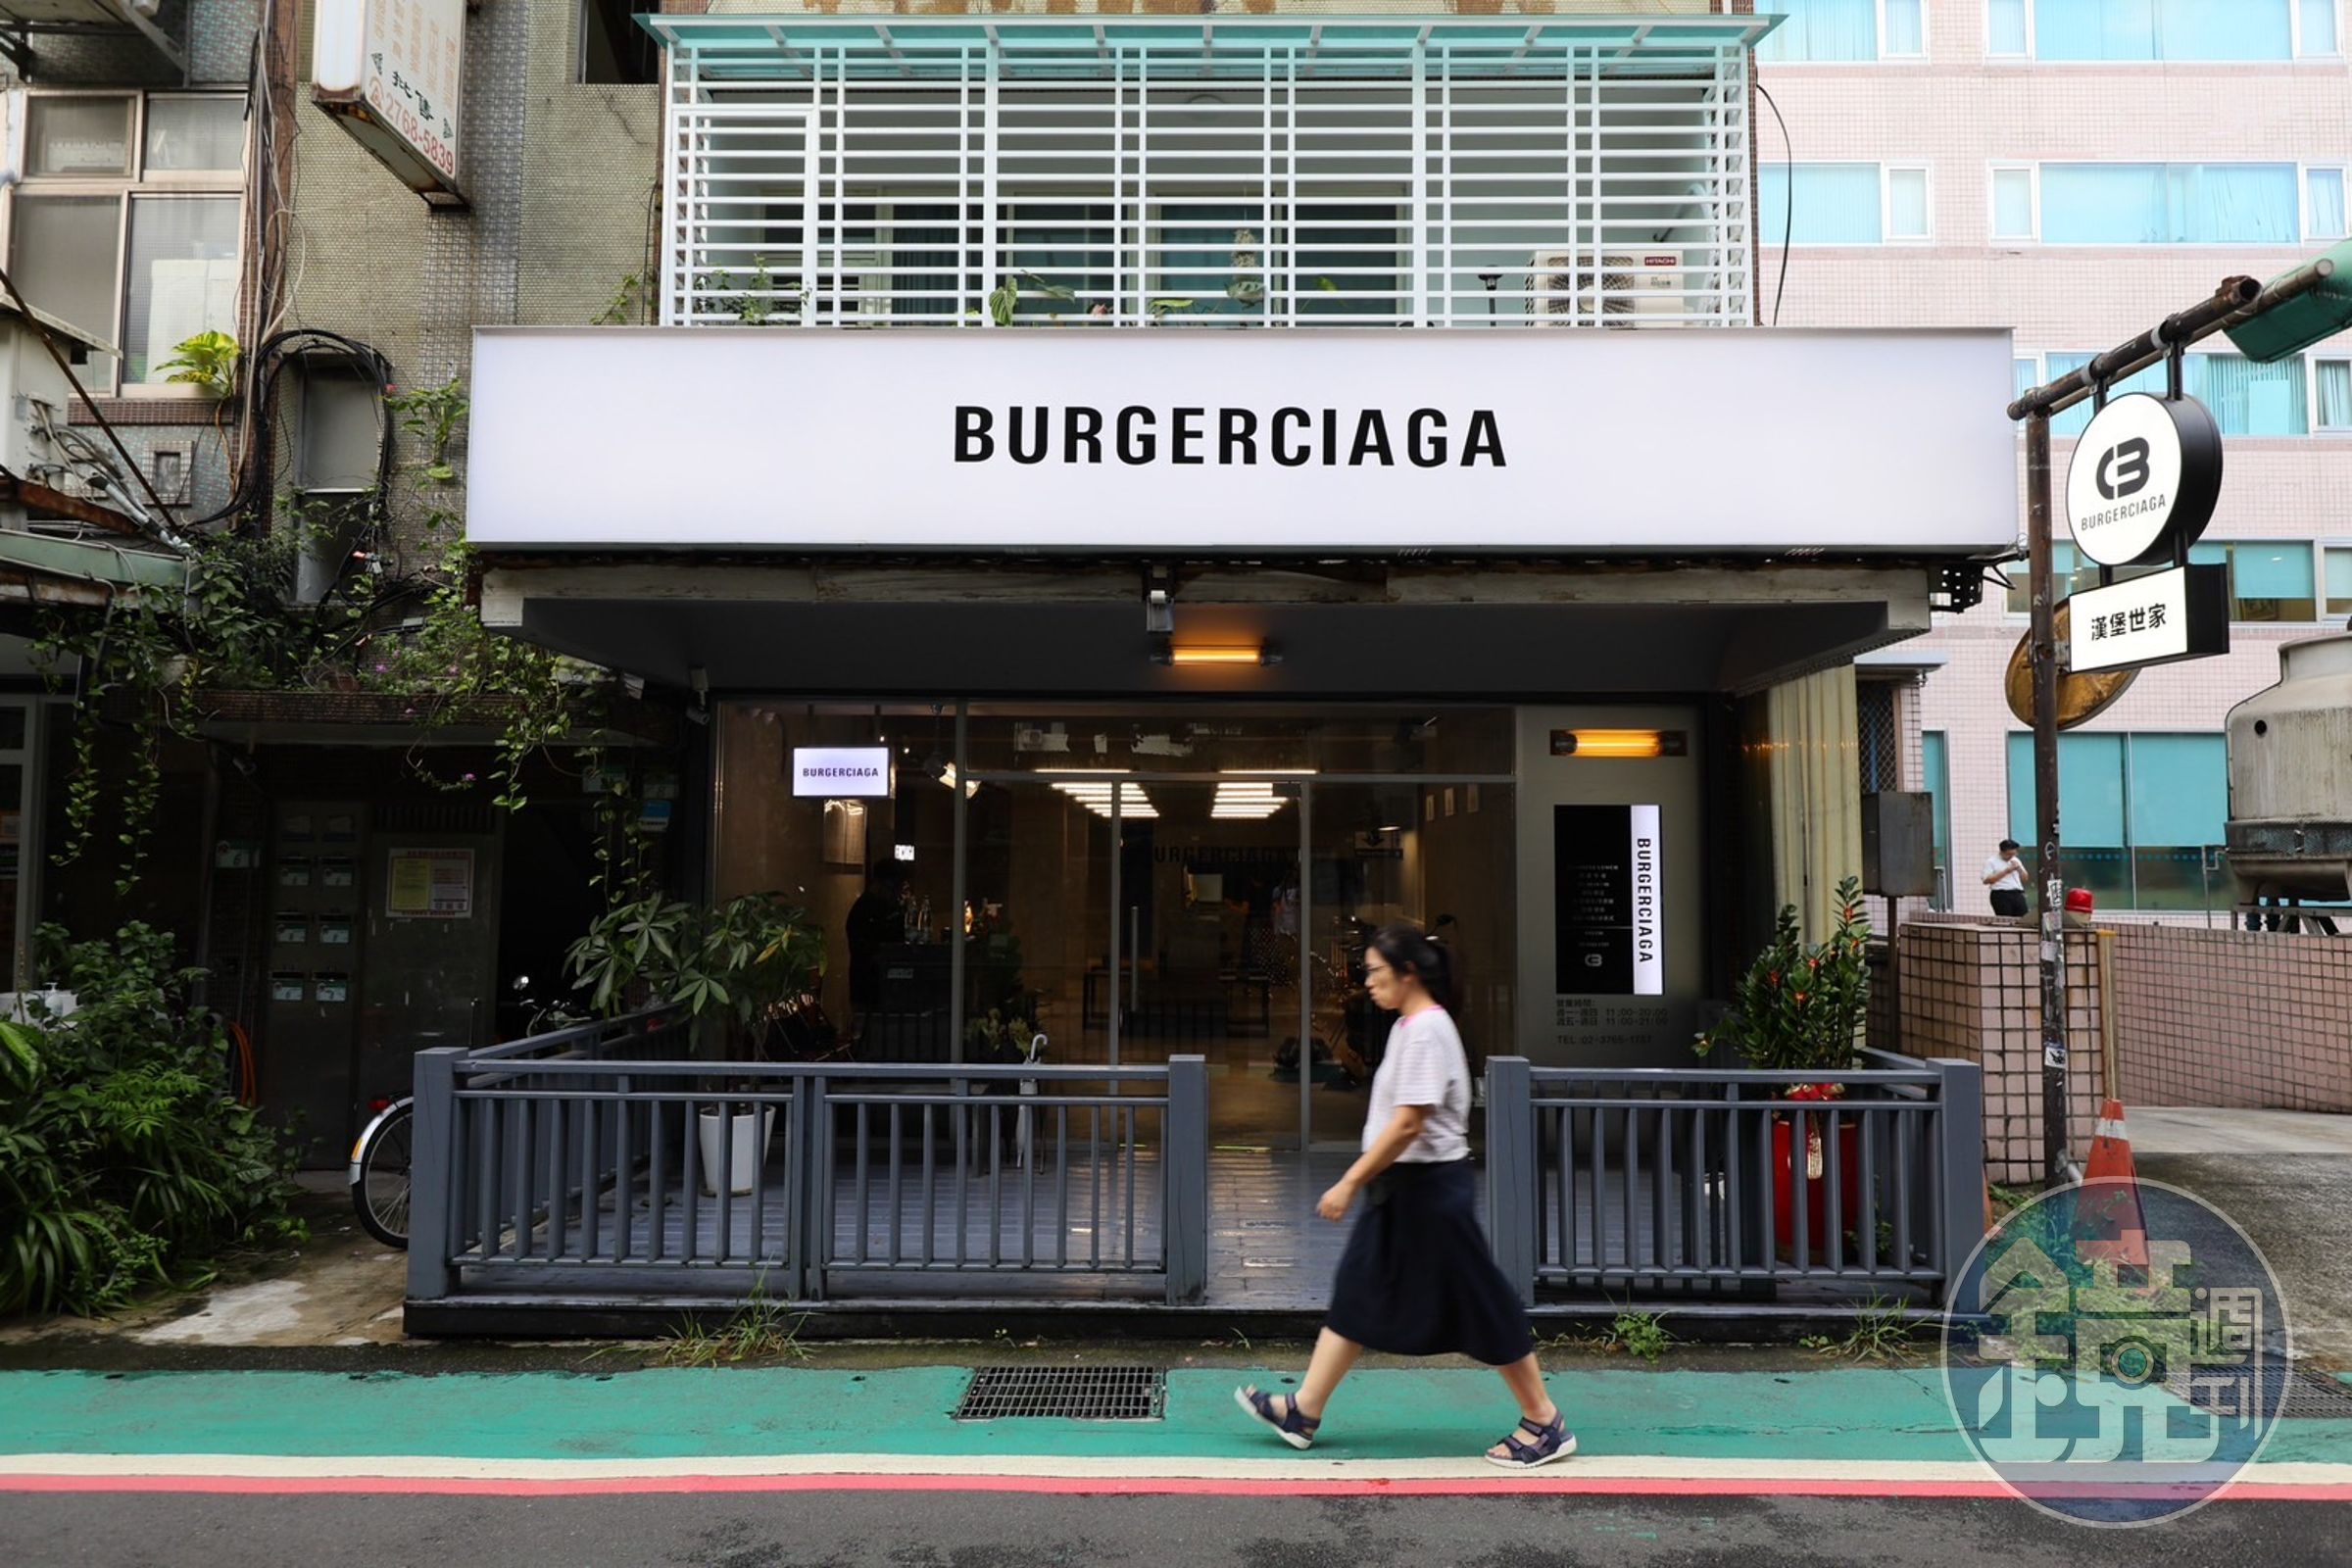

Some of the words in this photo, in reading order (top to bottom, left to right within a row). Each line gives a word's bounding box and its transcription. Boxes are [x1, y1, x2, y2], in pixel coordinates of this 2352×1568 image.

[385, 92, 454, 174] 2768-5839
[954, 405, 1506, 468] BURGERCIAGA
[2081, 493, 2167, 531] BURGERCIAGA
[2090, 603, 2167, 640] 漢堡世家
[803, 767, 879, 777] BURGERCIAGA
[1637, 838, 1653, 962] BURGERCIAGA
